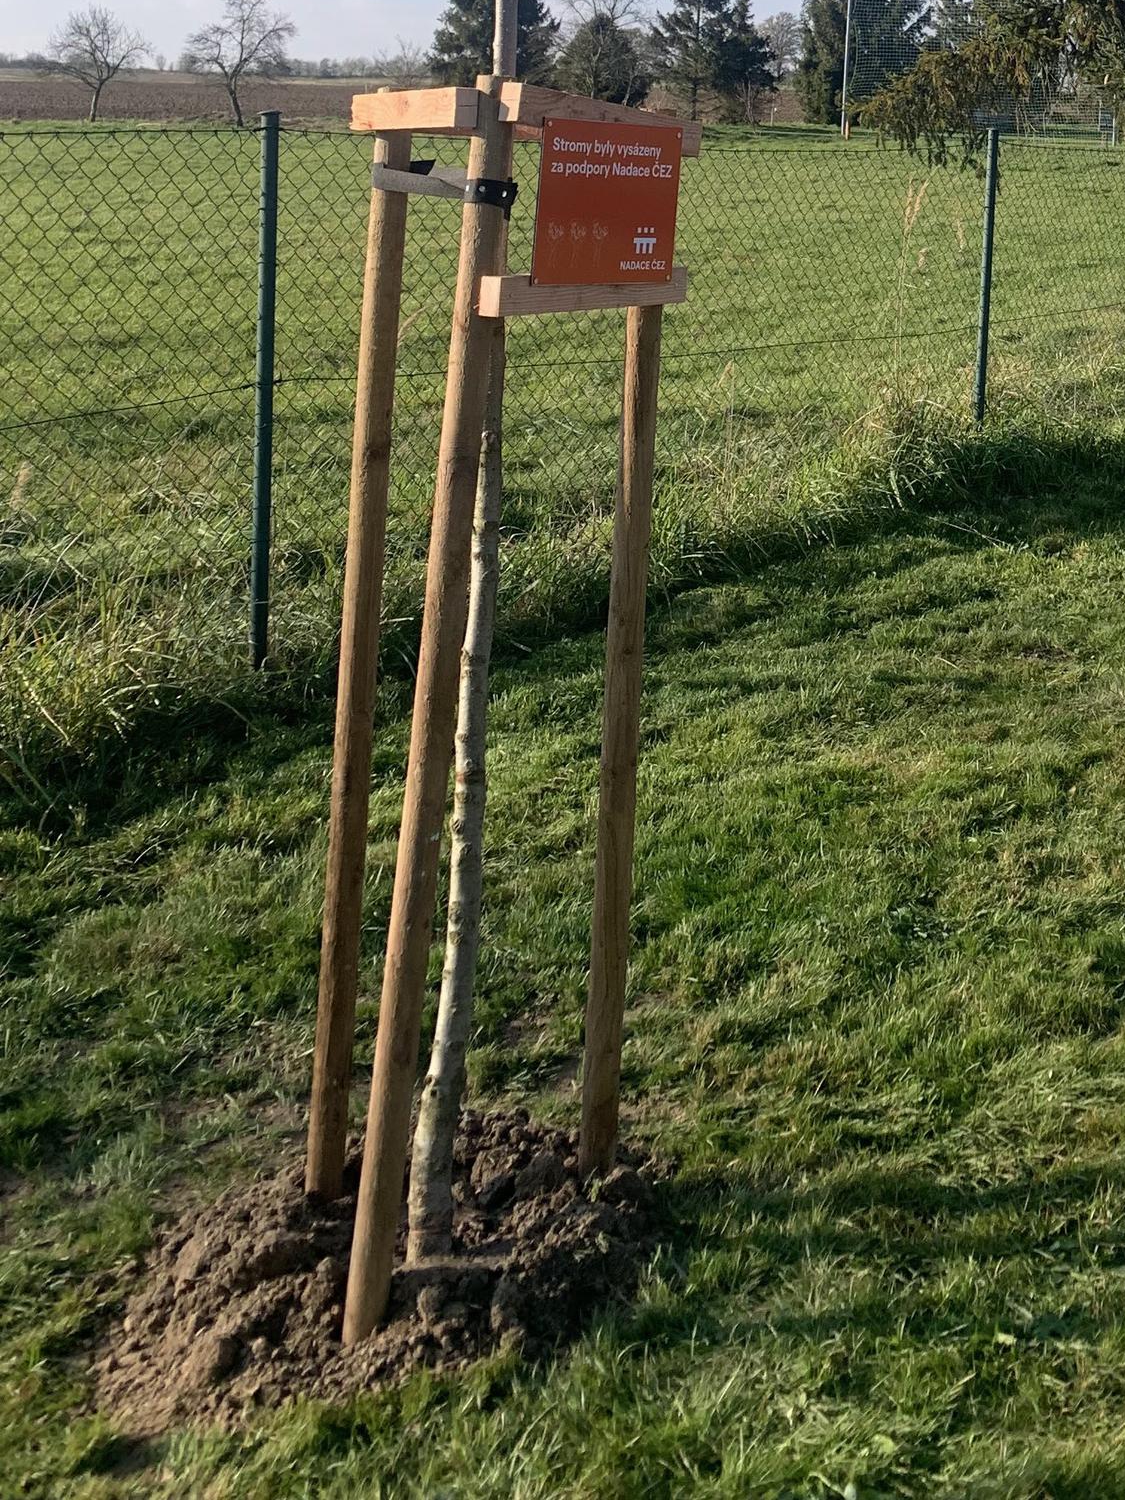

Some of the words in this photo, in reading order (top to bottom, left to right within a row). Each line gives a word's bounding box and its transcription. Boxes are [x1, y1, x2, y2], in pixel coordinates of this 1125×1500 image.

[553, 137, 592, 156] Stromy
[594, 139, 616, 157] byly
[617, 142, 661, 160] vysázeny
[551, 161, 563, 173] za
[565, 160, 610, 179] podpory
[612, 162, 650, 177] Nadace
[652, 161, 672, 178] ČEZ
[620, 261, 650, 270] NADACE
[651, 260, 665, 270] ČEZ
